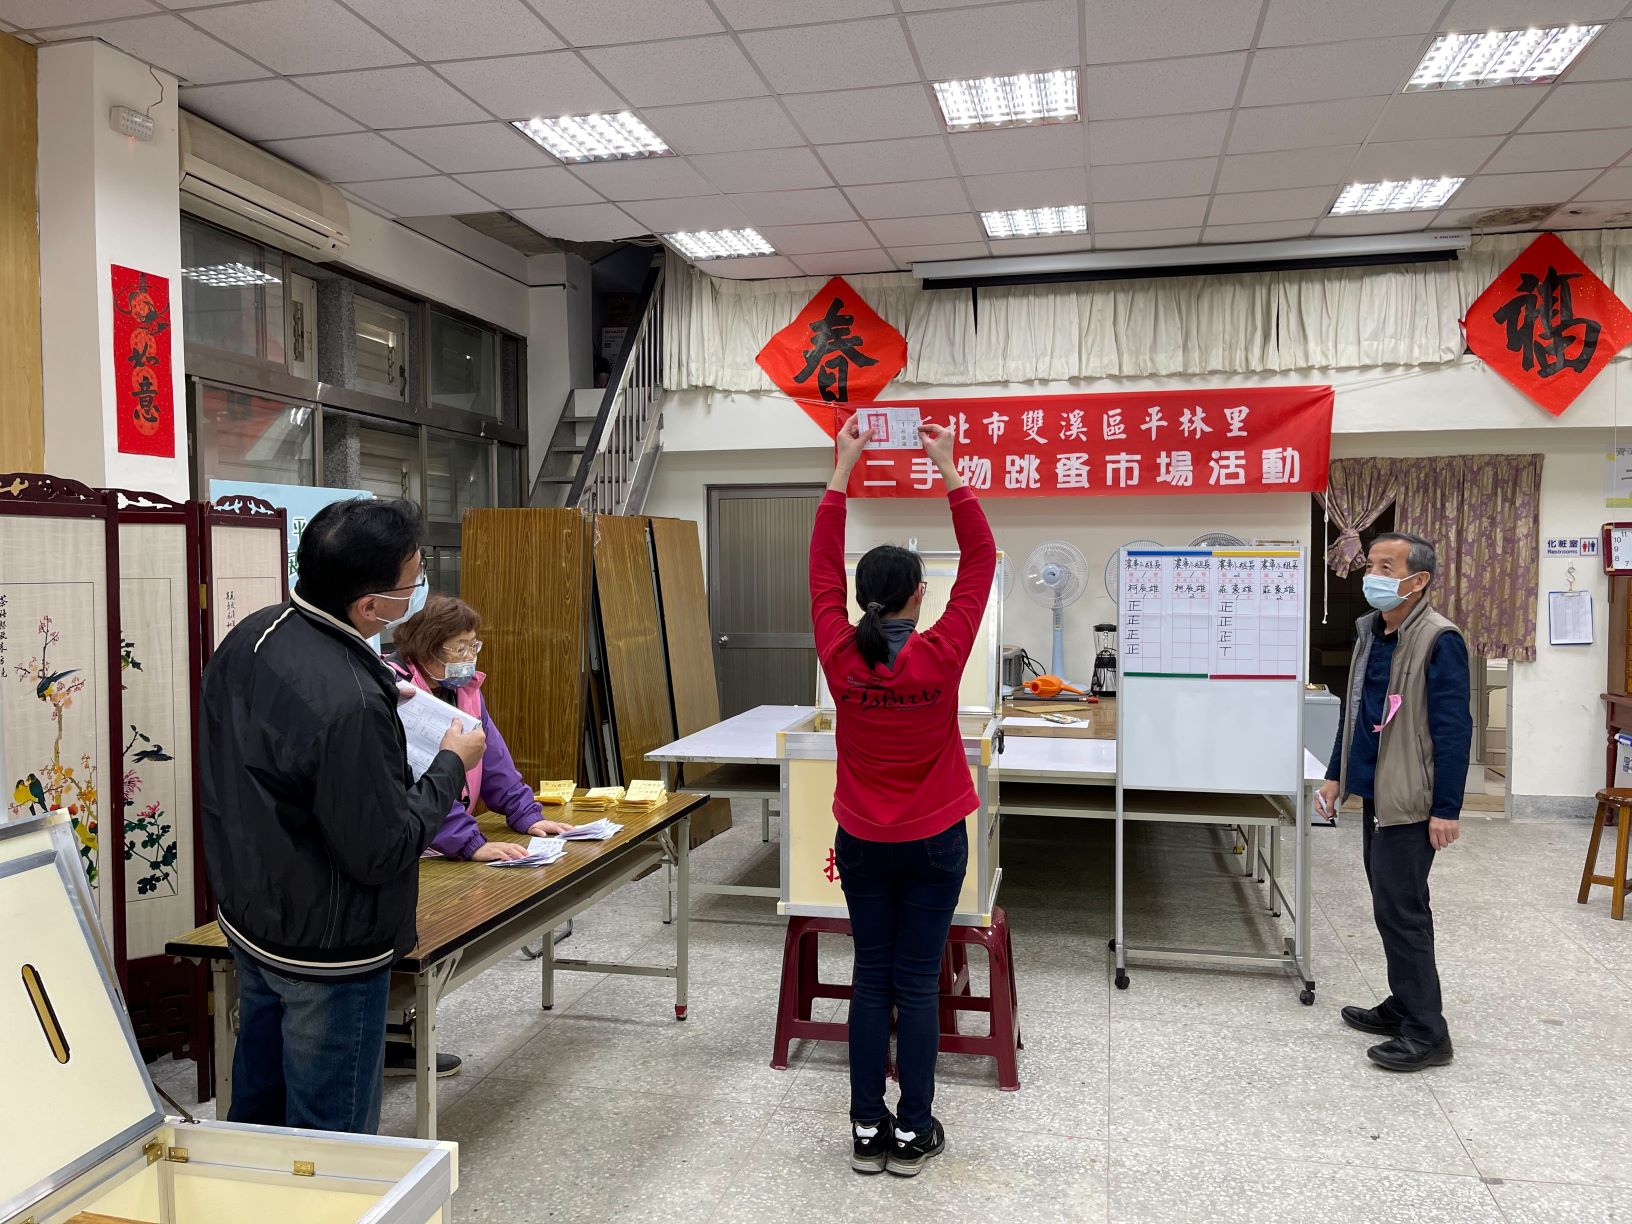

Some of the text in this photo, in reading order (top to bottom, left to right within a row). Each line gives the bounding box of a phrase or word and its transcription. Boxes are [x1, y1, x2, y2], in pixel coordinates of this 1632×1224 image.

[1493, 266, 1602, 378] 福
[793, 297, 880, 402] 春
[921, 405, 1250, 444] 北市雙溪區平林里
[863, 447, 1301, 490] 二手物跳蚤市場活動
[1547, 540, 1578, 548] 化粧室
[1127, 600, 1142, 612] 正
[1217, 601, 1234, 613] 正
[1126, 615, 1140, 625] 正
[1217, 616, 1233, 627] 正
[1125, 629, 1140, 640] 正
[1217, 630, 1233, 643] 正
[1125, 643, 1140, 655] 正
